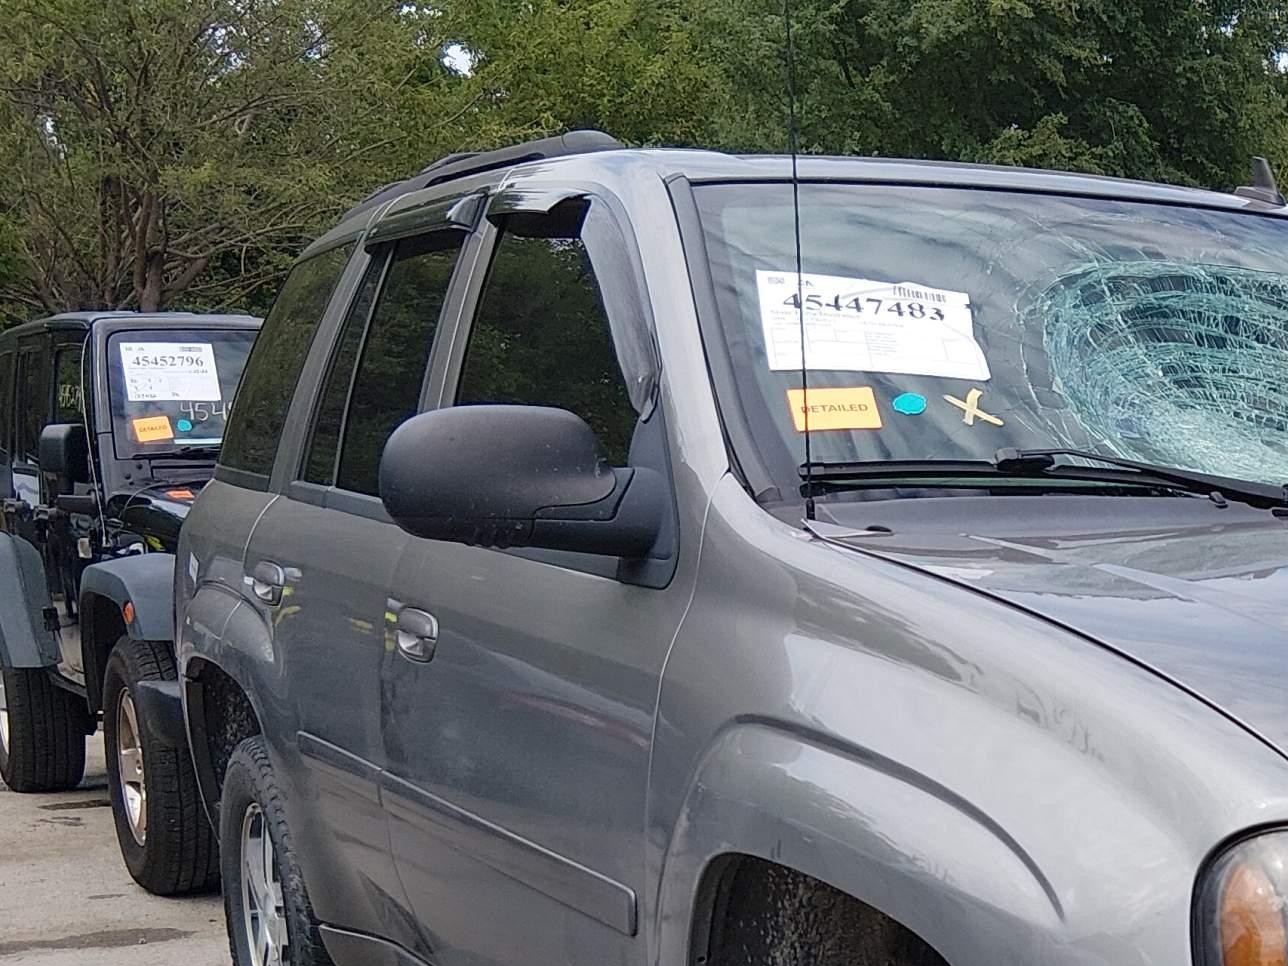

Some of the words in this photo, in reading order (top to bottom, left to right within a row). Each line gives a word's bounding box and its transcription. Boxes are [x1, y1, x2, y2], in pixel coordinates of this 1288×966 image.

[783, 292, 945, 321] 45447483
[132, 355, 204, 367] 45452796
[801, 404, 869, 414] DETAILED
